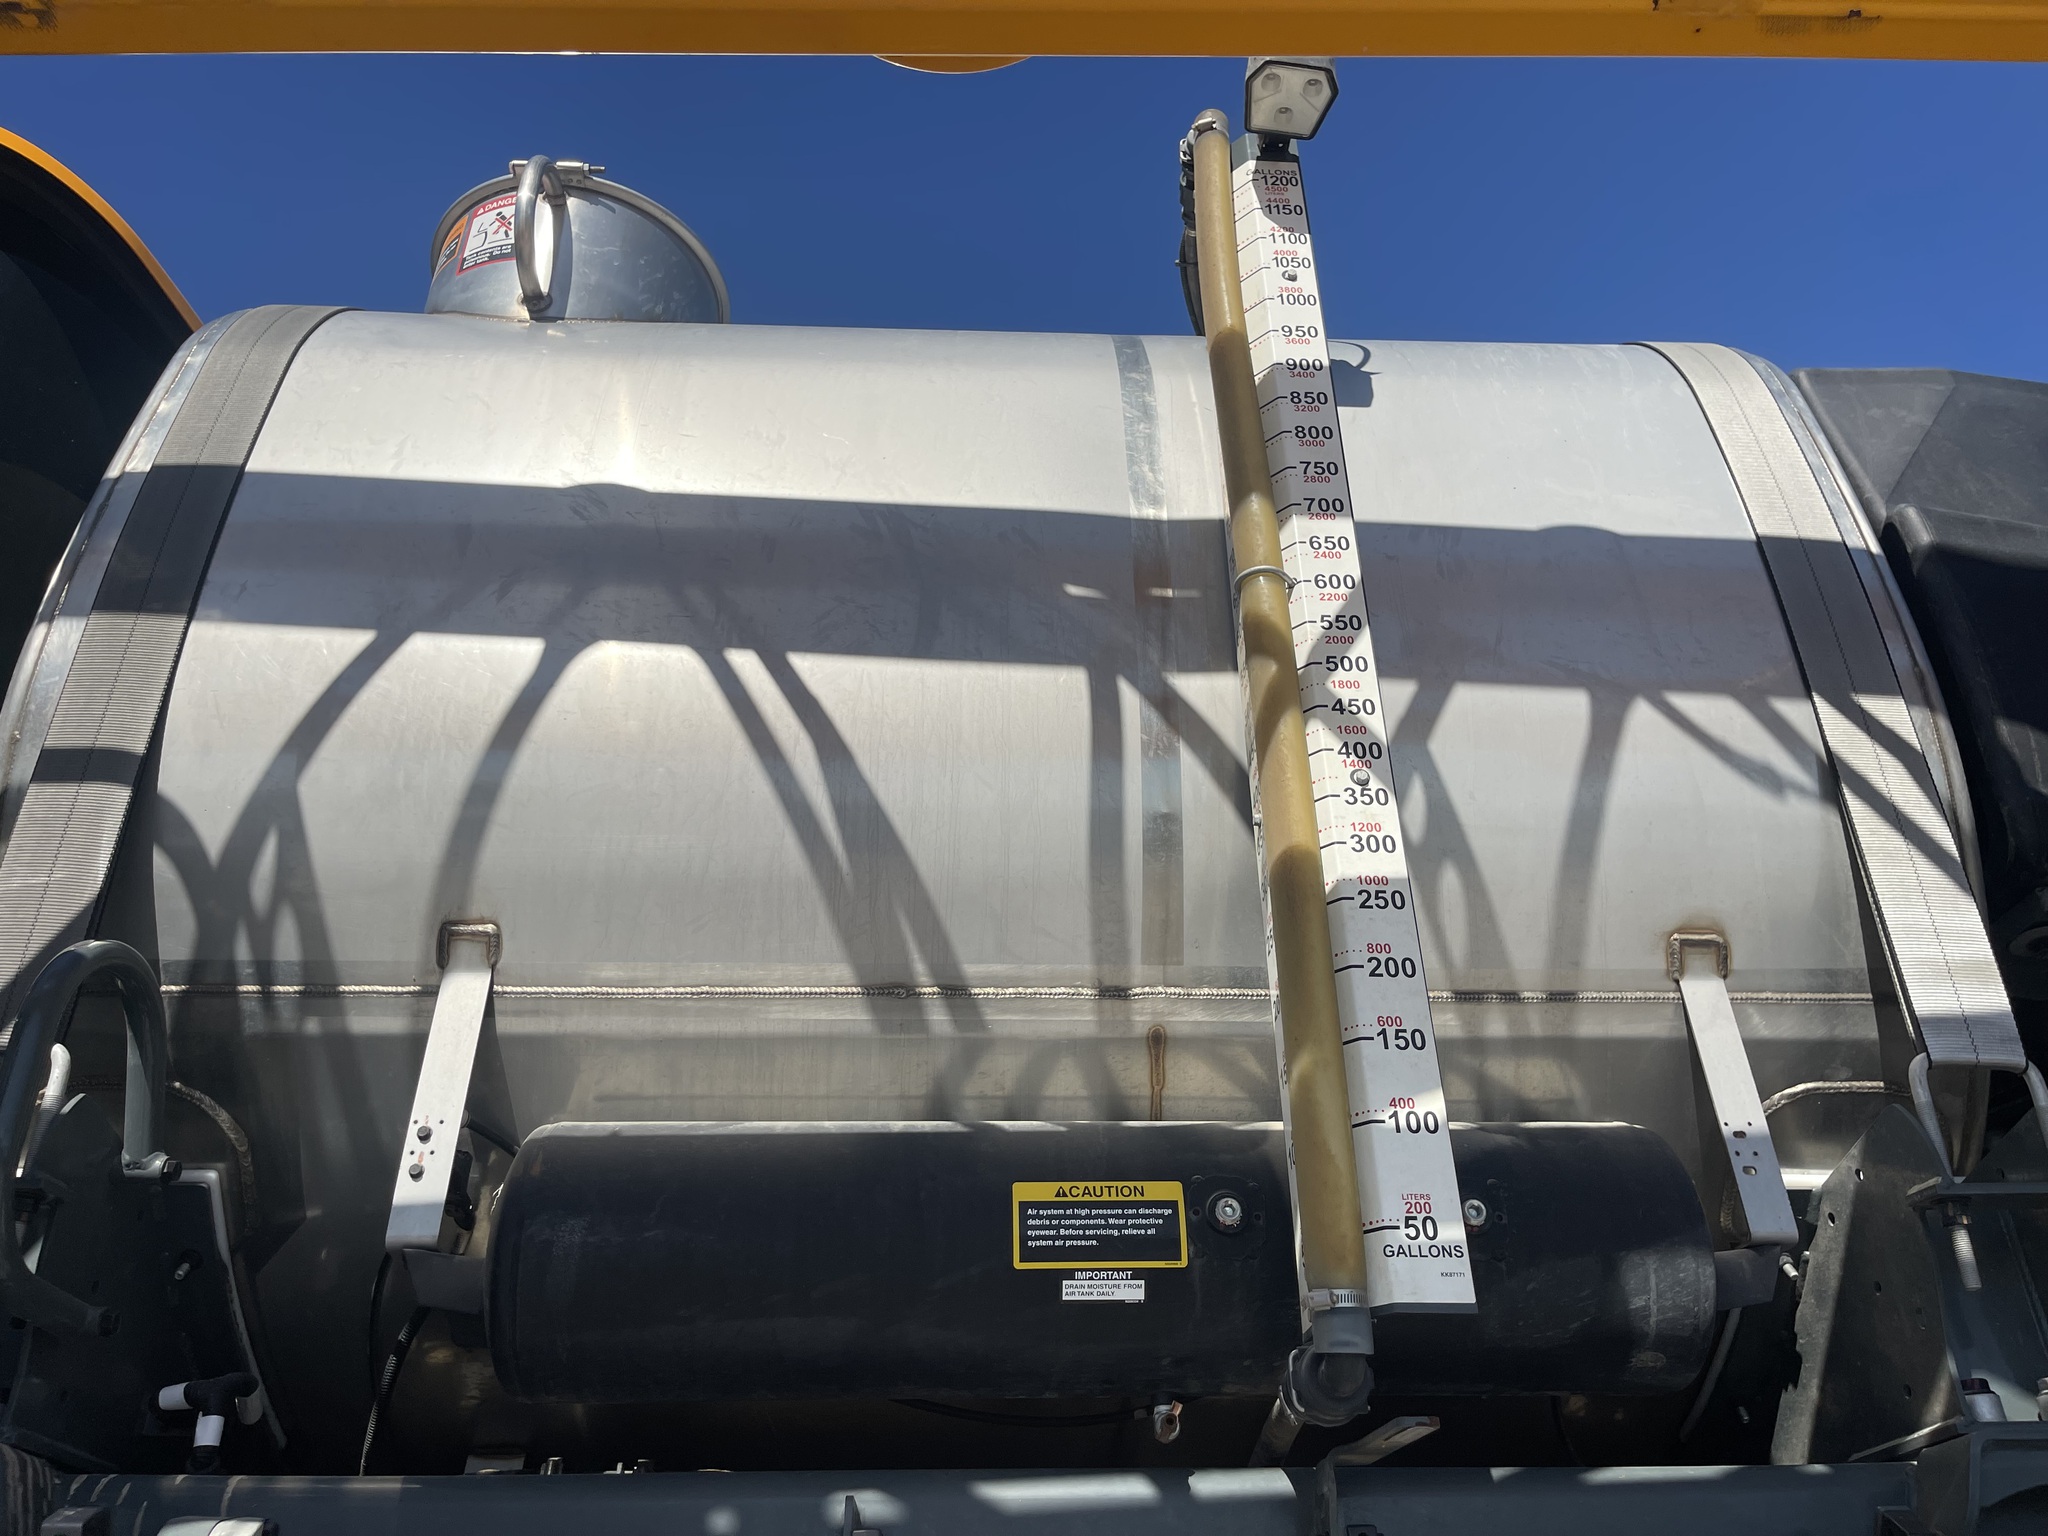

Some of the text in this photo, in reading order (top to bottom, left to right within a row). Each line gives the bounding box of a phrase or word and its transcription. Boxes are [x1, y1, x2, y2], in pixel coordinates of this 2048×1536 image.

[1261, 176, 1298, 186] 1200
[485, 197, 517, 210] DANGE
[1265, 204, 1303, 215] 1150
[1269, 233, 1308, 245] 1100
[1272, 257, 1311, 269] 1050
[1277, 294, 1316, 306] 1000
[1281, 326, 1318, 338] 950
[1285, 359, 1323, 371] 900
[1290, 391, 1328, 405] 850
[1295, 426, 1333, 439] 800
[1300, 461, 1339, 476] 750
[1303, 498, 1344, 513] 700
[1309, 536, 1350, 551] 650
[1313, 551, 1341, 559] 2400
[1314, 574, 1355, 589] 600
[1319, 593, 1348, 601] 2200
[1320, 615, 1362, 631] 550
[1325, 636, 1354, 644] 2000
[1325, 656, 1368, 672] 500
[1330, 680, 1360, 689] 1800
[1332, 698, 1375, 715] 450
[1337, 725, 1367, 734] 1600
[1338, 742, 1382, 759] 400
[1342, 759, 1372, 768] 1400
[1344, 787, 1389, 806] 350
[1350, 822, 1382, 832] 1200
[1350, 834, 1396, 853] 300
[1356, 876, 1388, 886] 1000
[1357, 890, 1406, 909] 250
[1366, 943, 1391, 954] 800
[1367, 957, 1416, 978] 200
[1377, 1016, 1403, 1027] 600
[1376, 1028, 1426, 1050] 150
[1389, 1097, 1415, 1110] 400
[1387, 1111, 1439, 1134] 100
[1069, 1185, 1145, 1198] CAUTION
[1402, 1193, 1431, 1201] LITERS
[1039, 1208, 1064, 1216] system
[1074, 1208, 1090, 1216] high
[1092, 1208, 1122, 1216] pressure
[1139, 1207, 1172, 1215] discharge
[1405, 1201, 1432, 1214] 200
[1060, 1218, 1107, 1226] components.
[1128, 1217, 1163, 1225] protective
[1027, 1229, 1058, 1237] eyewear.
[1085, 1228, 1120, 1236] servicing,
[1404, 1216, 1438, 1241] 50
[1028, 1239, 1053, 1247] system
[1066, 1239, 1099, 1247] pressure.
[1383, 1244, 1464, 1259] GALLONS
[1075, 1271, 1132, 1280] IMPORTANT
